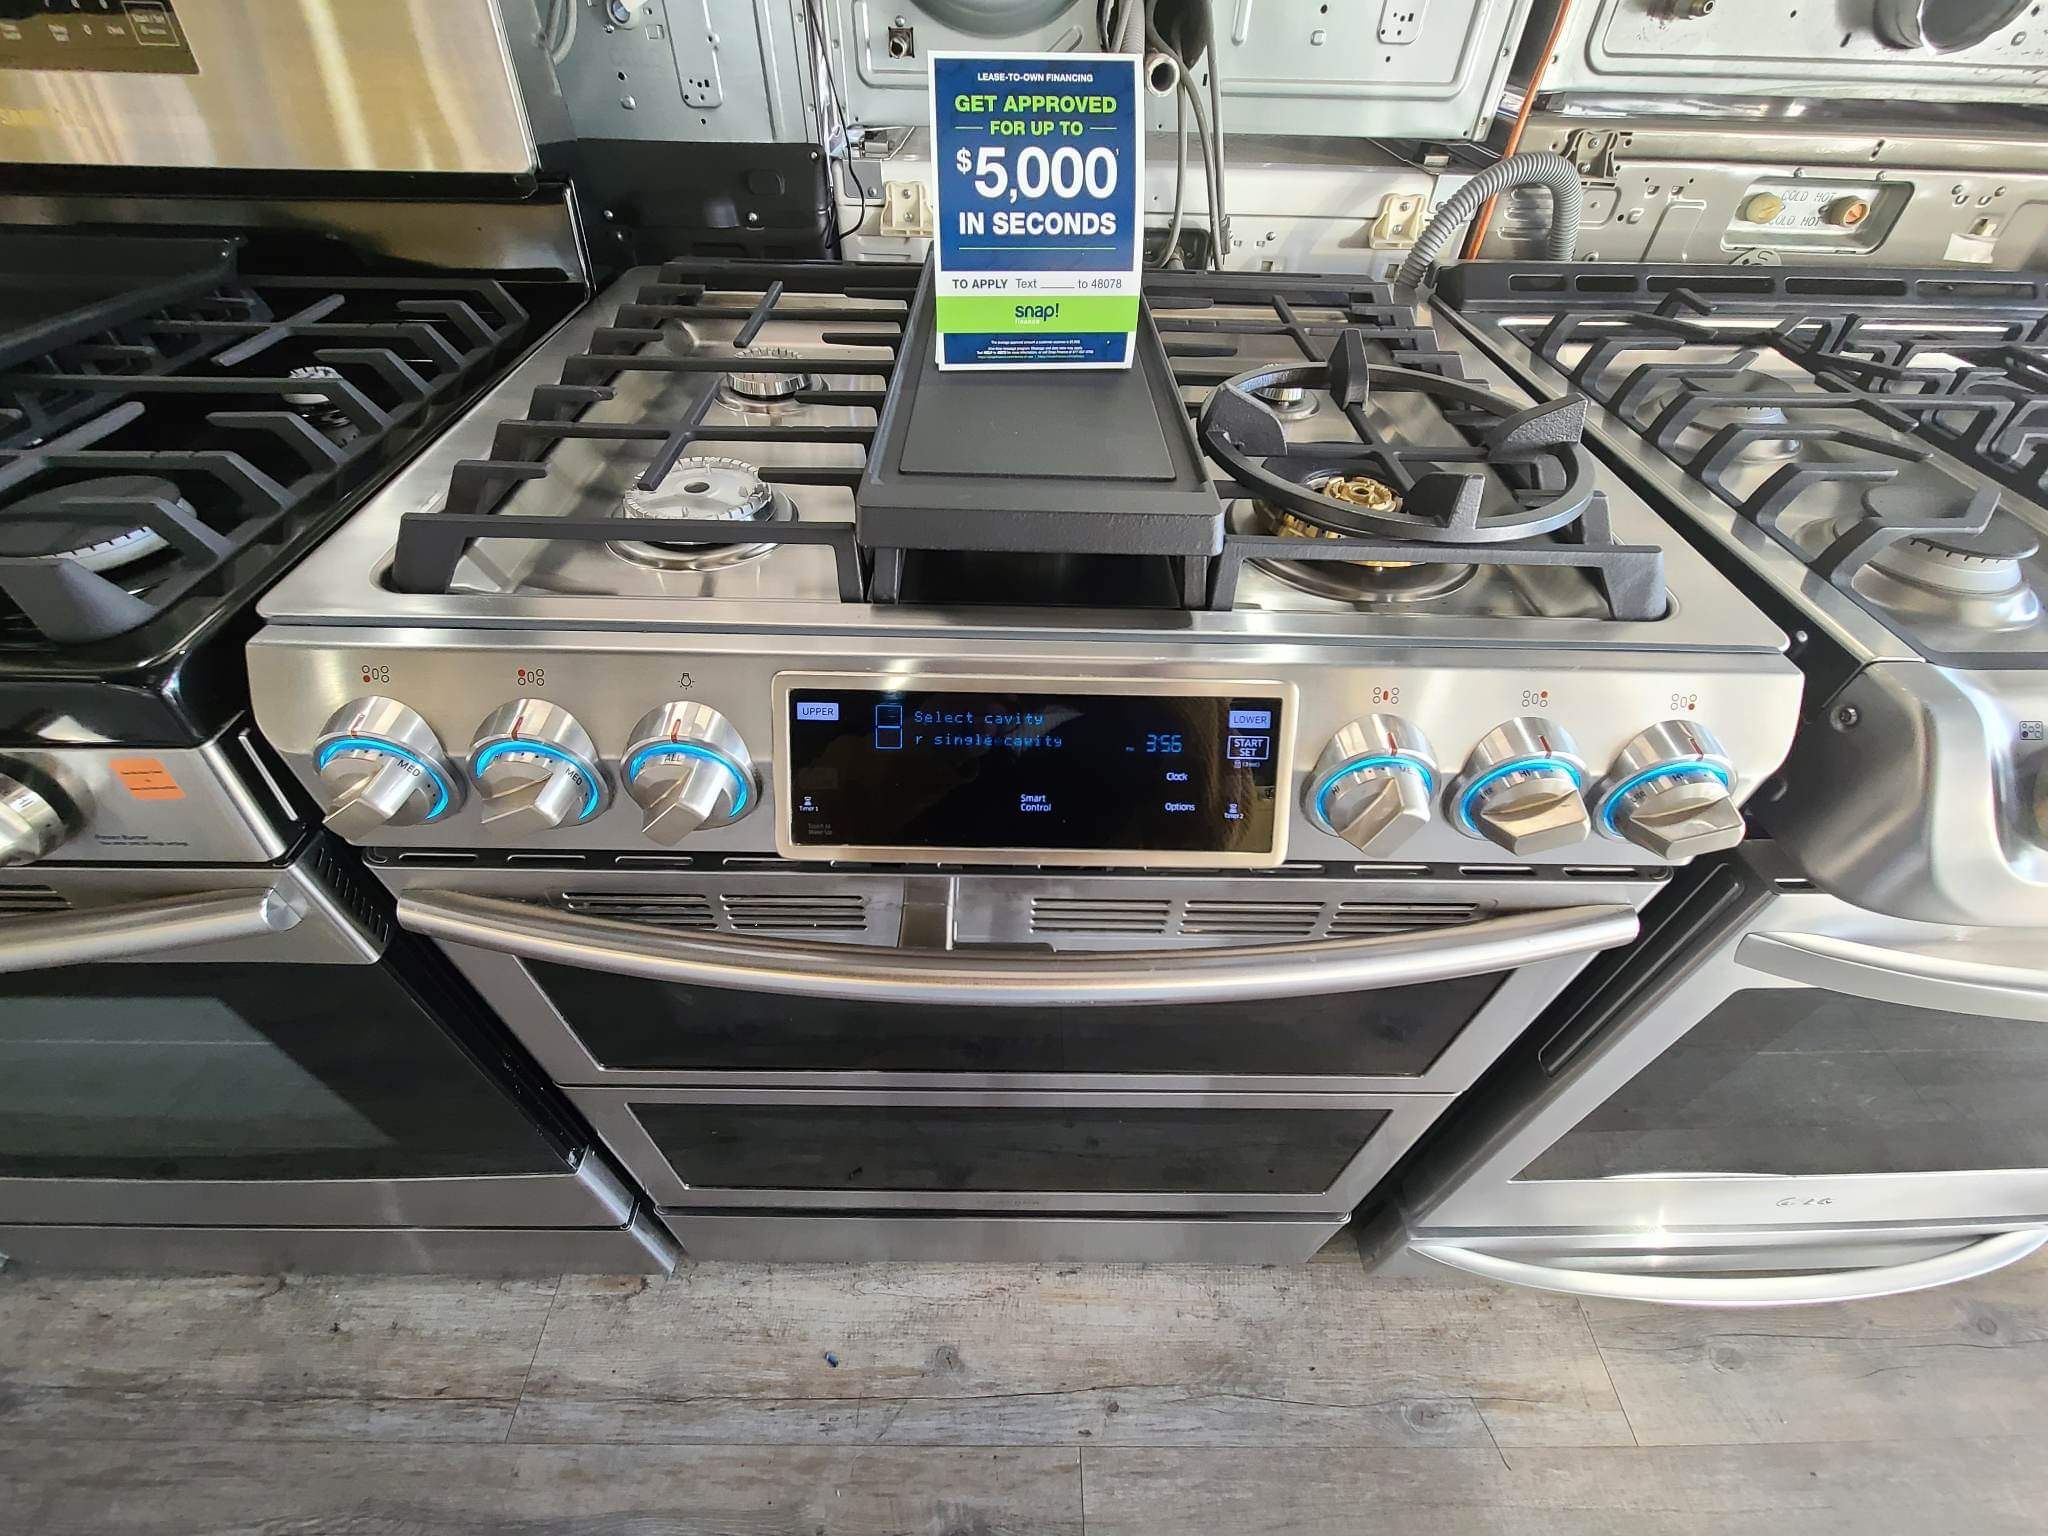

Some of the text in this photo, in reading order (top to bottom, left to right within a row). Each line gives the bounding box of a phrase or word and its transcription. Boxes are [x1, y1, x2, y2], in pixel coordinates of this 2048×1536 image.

[977, 72, 1093, 82] LEASE-TO-OWN FINANCING
[954, 95, 1117, 113] GET APPROVED
[990, 121, 1083, 135] FOR UP TO
[1781, 190, 1809, 202] COLD
[959, 212, 1117, 235] IN SECONDS
[1800, 216, 1823, 227] HOT
[952, 279, 1122, 289] TO APPLY Text to 48078
[1015, 303, 1059, 321] snap!
[802, 707, 834, 716] UPPER
[914, 711, 1043, 725] Select cavity
[1233, 715, 1267, 724] LOWER
[934, 733, 993, 747] single
[1004, 735, 1062, 747] cavity
[1234, 739, 1263, 748] START
[1239, 748, 1257, 757] SET
[397, 759, 421, 777] MED
[565, 767, 583, 786] MED
[1166, 772, 1188, 781] Clock
[1020, 794, 1046, 802] Smart
[1020, 803, 1051, 811] Control
[1165, 802, 1195, 812] Options
